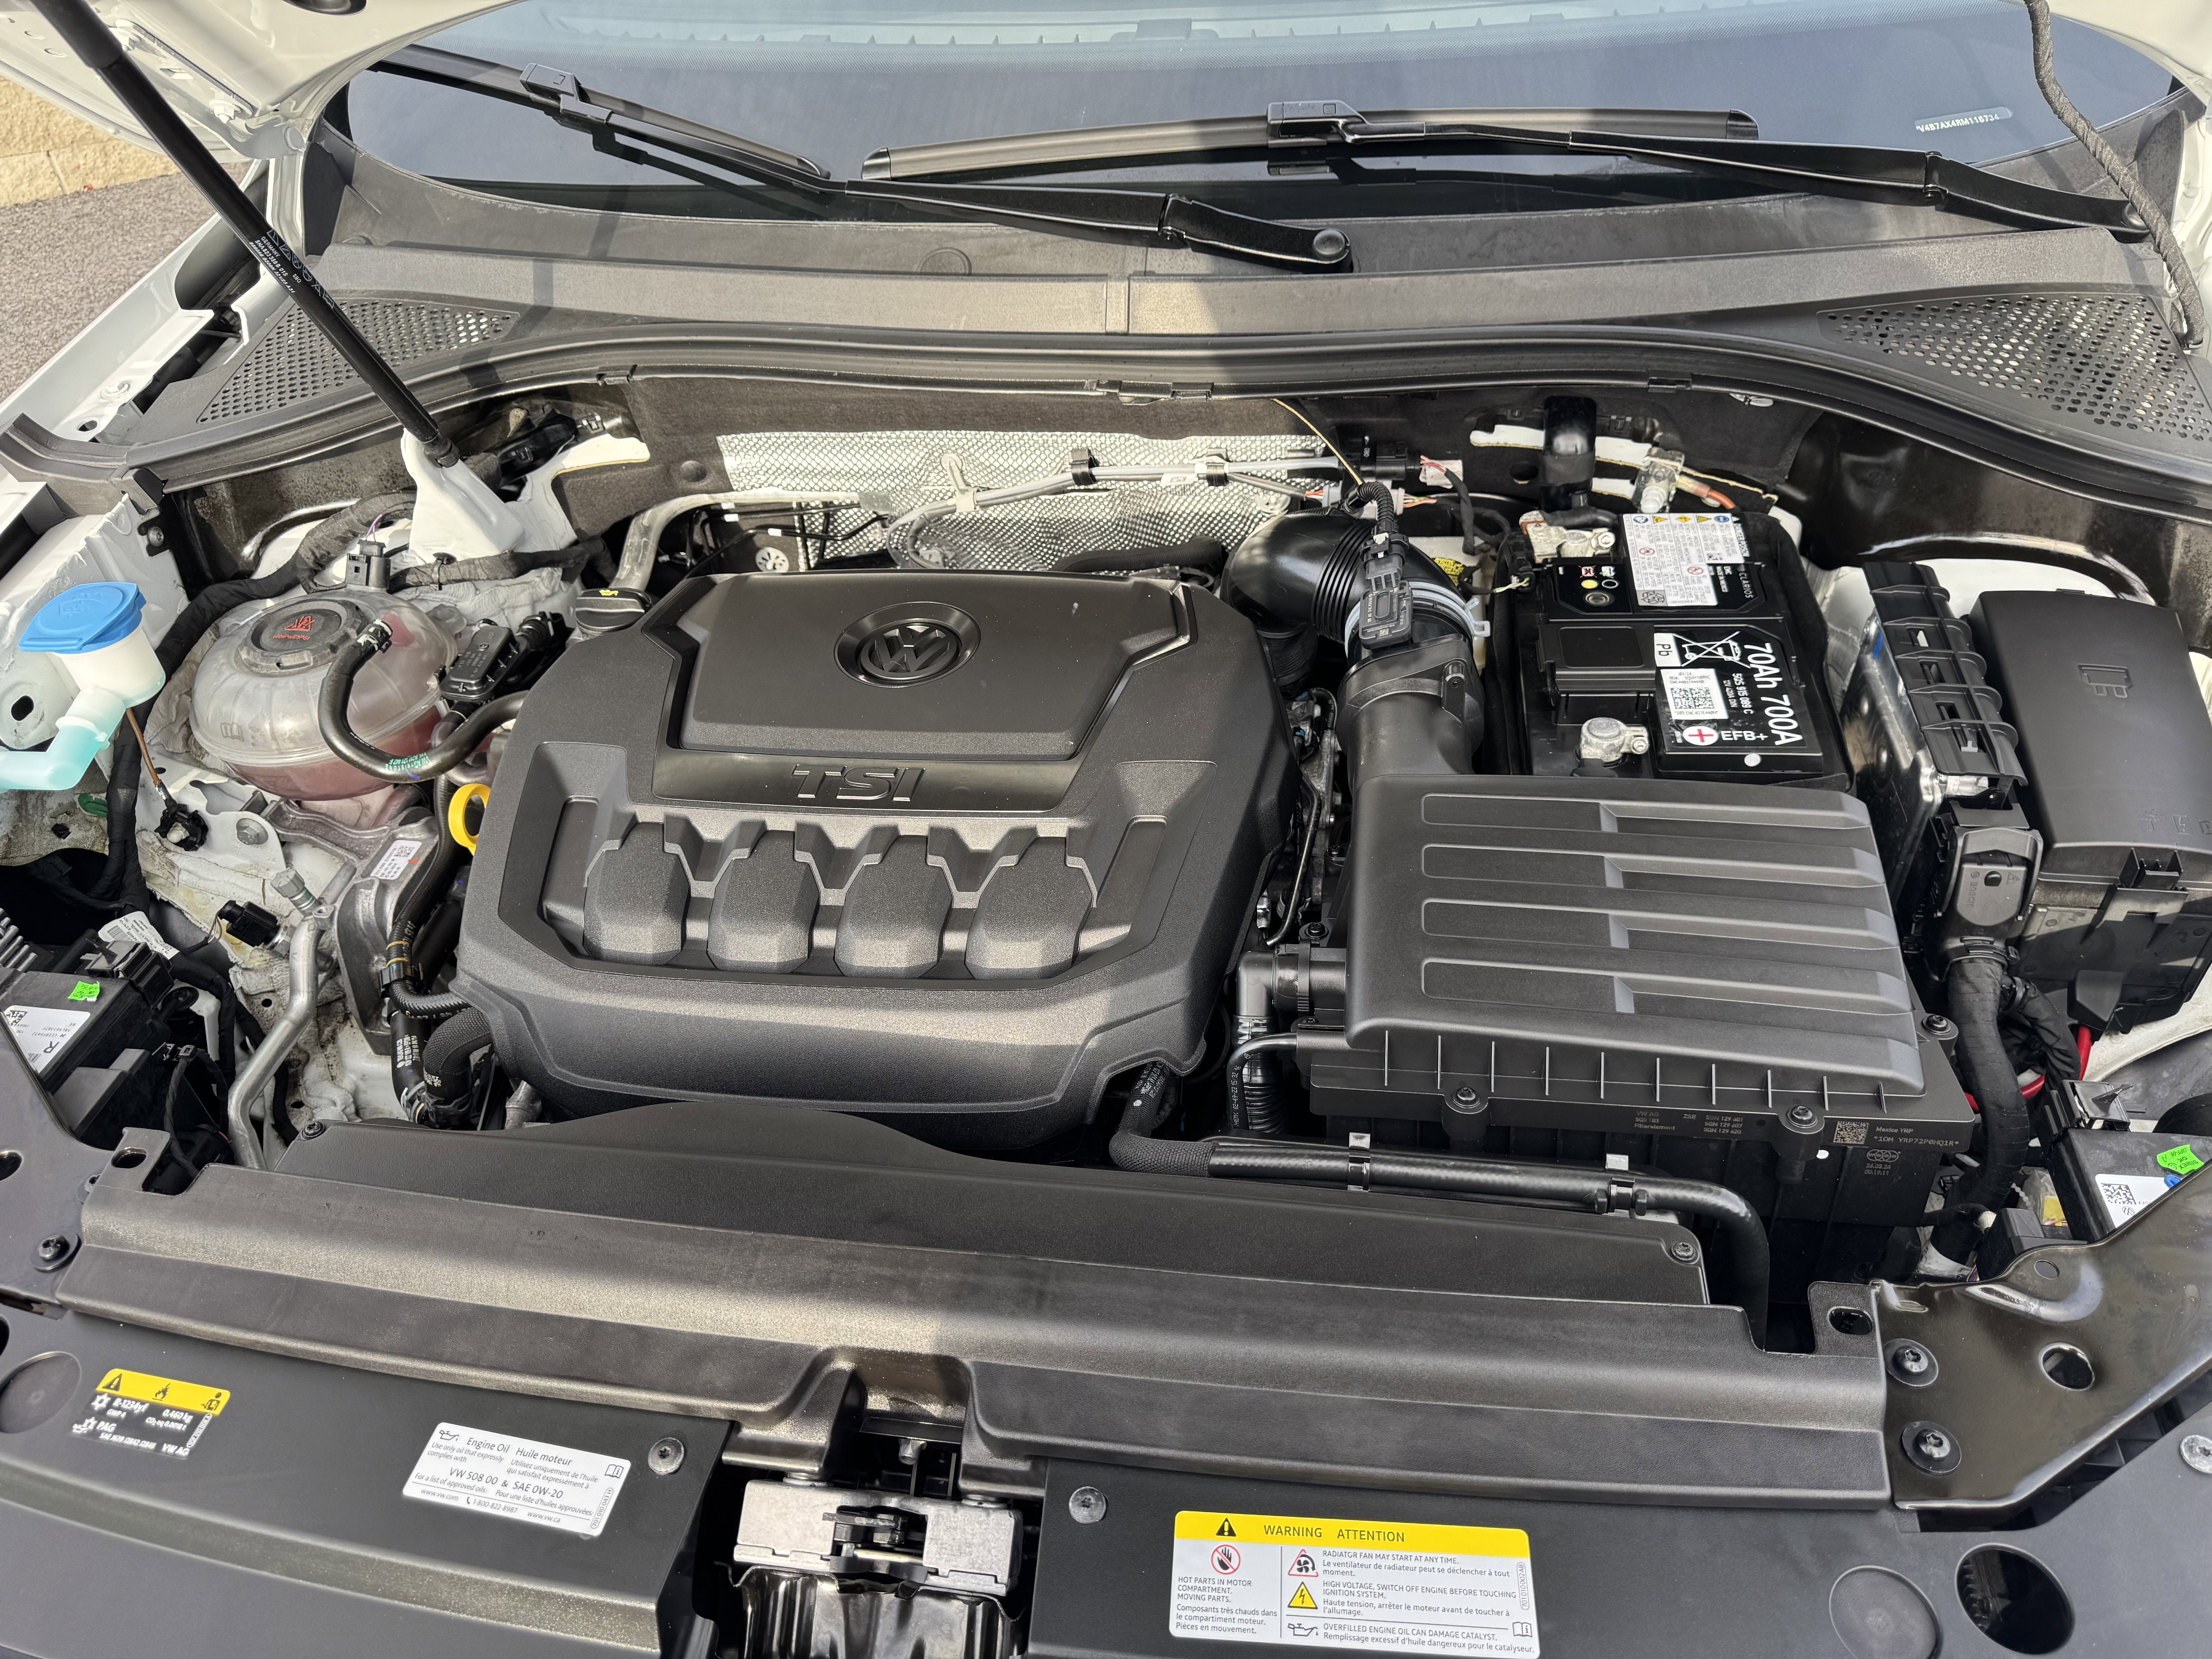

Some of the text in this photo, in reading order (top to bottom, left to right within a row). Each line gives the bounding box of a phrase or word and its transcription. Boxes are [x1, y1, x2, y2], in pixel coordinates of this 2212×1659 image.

[261, 236, 281, 258] GERMANY
[279, 268, 289, 276] 01S
[1739, 572, 1753, 598] CLARIOS
[1656, 644, 1673, 656] Pb
[1732, 673, 1745, 685] 5QS
[1736, 686, 1748, 696] 915
[1744, 643, 1800, 746] 70Ah 700A
[1739, 697, 1752, 708] 089
[1721, 731, 1769, 740] EFB+
[792, 764, 926, 802] TSI
[43, 1041, 60, 1053] R
[112, 1398, 149, 1413] R-1234yf
[96, 1421, 117, 1432] PAG
[162, 1443, 190, 1456] VW AG
[467, 1437, 510, 1453] Engine Oil
[427, 1450, 453, 1460] complies
[477, 1452, 504, 1463] expressly
[515, 1447, 572, 1466] Huile moteur
[511, 1459, 533, 1469] Utilisez
[533, 1465, 571, 1477] uniquement
[579, 1473, 598, 1483] l'huile
[450, 1467, 467, 1478] VW
[466, 1471, 484, 1482] 508
[485, 1475, 498, 1485] 00
[512, 1481, 532, 1492] SAE
[532, 1485, 563, 1498] 0W-20
[517, 1470, 542, 1479] satisfait
[542, 1475, 584, 1488] expressément
[447, 1480, 476, 1491] approved
[421, 1489, 459, 1501] www.vw.com
[495, 1489, 510, 1498] Pour
[522, 1495, 534, 1503] liste
[534, 1498, 558, 1508] d'huiles
[473, 1499, 518, 1513] 1-800-822-8987
[527, 1512, 561, 1523] www.vw.ca
[1264, 1525, 1404, 1542] WARNING ATTENTION
[1323, 1550, 1357, 1558] RADIATOR
[1384, 1563, 1417, 1571] radiateur
[1447, 1566, 1487, 1575] déclencher
[1178, 1584, 1232, 1594] COMPARTMENT.
[1323, 1589, 1386, 1599] IGNITION SYSTEM.
[1342, 1582, 1375, 1590] VOLTAGE,
[1377, 1583, 1404, 1592] SWITCH
[1449, 1588, 1477, 1596] BEFORE
[1479, 1590, 1516, 1598] TOUCHING
[1323, 1598, 1345, 1608] Haute
[1347, 1601, 1376, 1609] tension,
[1378, 1602, 1403, 1610] arrêter
[1176, 1604, 1219, 1613] Composants
[1235, 1607, 1259, 1616] chauds
[1261, 1609, 1277, 1617] dans
[1323, 1606, 1363, 1617] l'allumage.
[1184, 1615, 1236, 1623] compartiment
[1176, 1622, 1198, 1630] Pièces
[1211, 1626, 1257, 1634] mouvement.
[1323, 1623, 1367, 1632] OVERFILLED
[1369, 1626, 1396, 1634] ENGINE
[1429, 1630, 1460, 1638] DAMAGE
[1461, 1632, 1498, 1641] CATALYST.
[1324, 1632, 1369, 1644] Remplissage
[1401, 1637, 1425, 1645] d'huile
[1427, 1639, 1466, 1649] dangereux
[1495, 1644, 1534, 1653] catalyseur.
